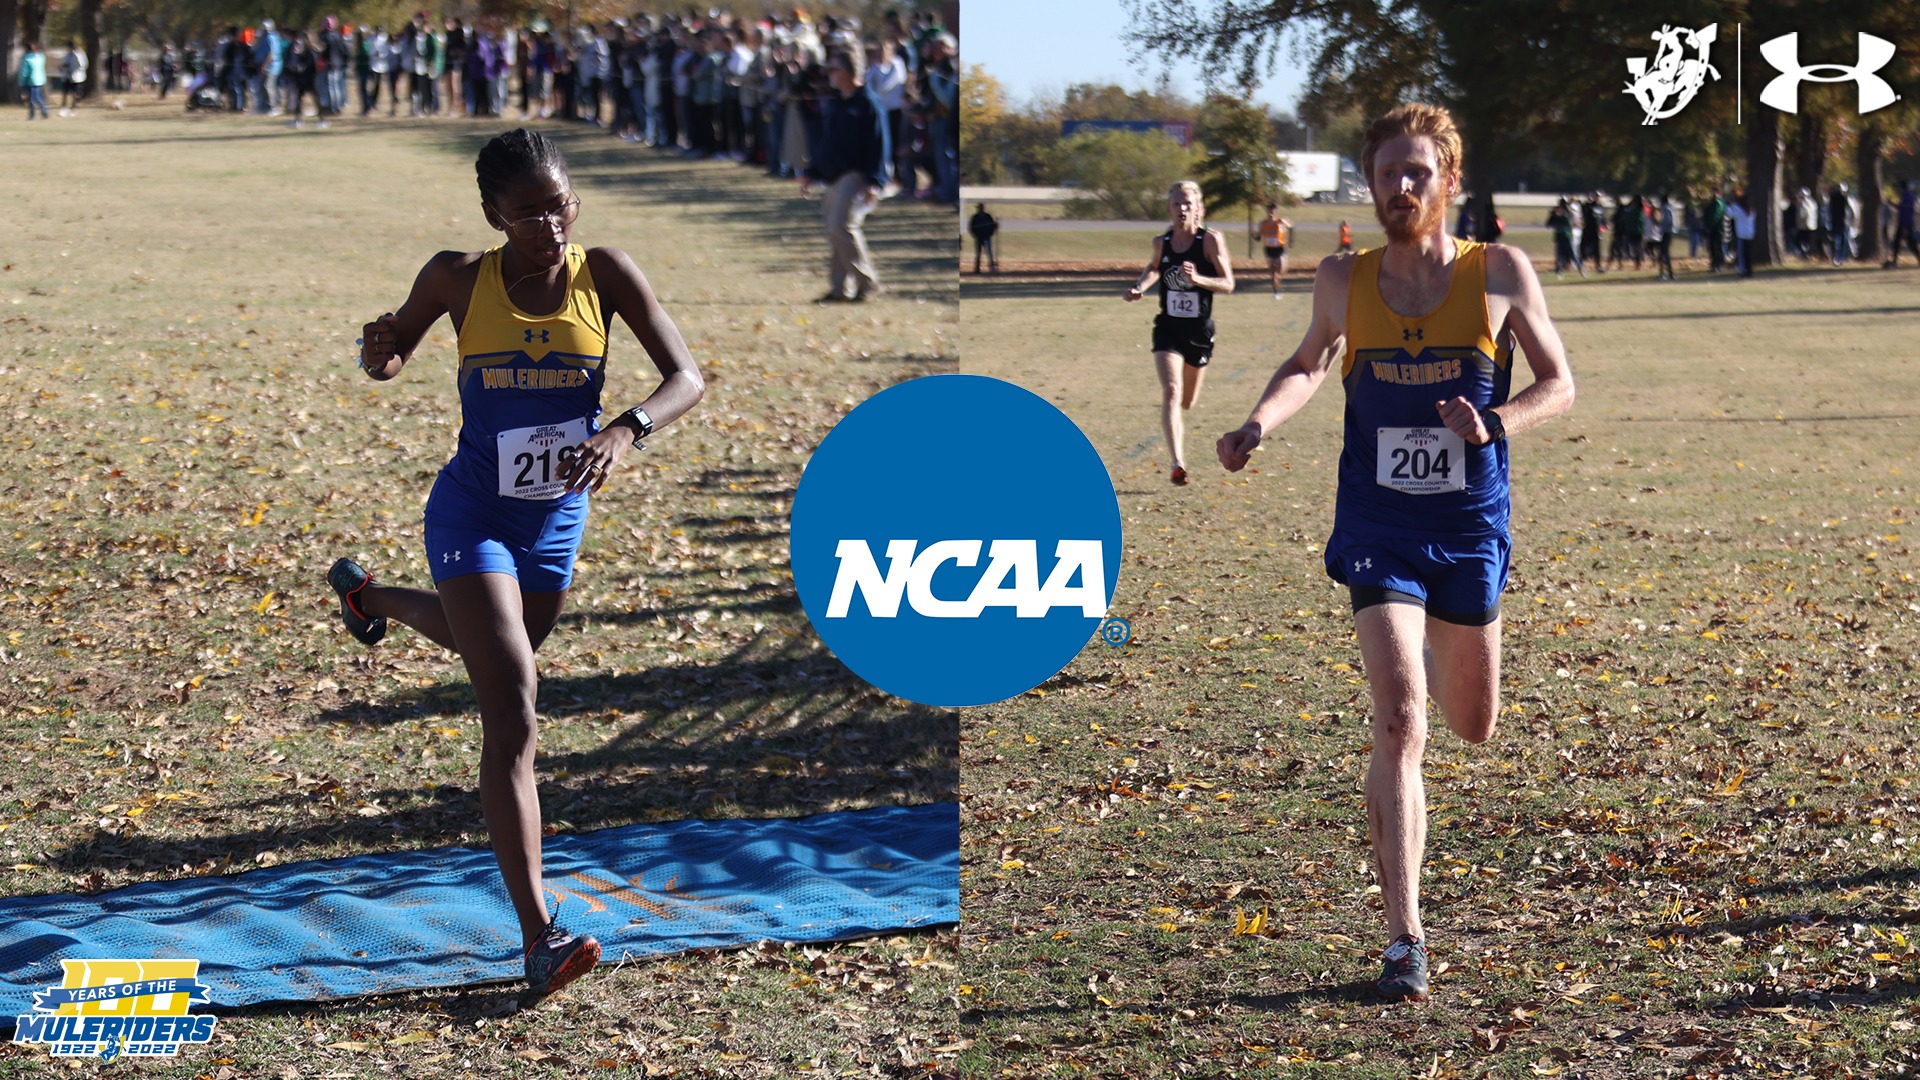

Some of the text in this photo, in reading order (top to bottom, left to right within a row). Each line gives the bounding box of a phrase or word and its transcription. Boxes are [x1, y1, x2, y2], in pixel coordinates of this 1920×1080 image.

[1171, 299, 1193, 312] 142
[482, 368, 587, 389] MULERIDERS
[1371, 359, 1462, 385] MULERIDERS
[536, 426, 557, 434] GREAT
[527, 431, 566, 444] AMERICAN
[1403, 433, 1439, 442] AMERICAN
[1391, 448, 1451, 480] 204
[515, 487, 529, 495] 2022
[530, 484, 549, 493] CROSS
